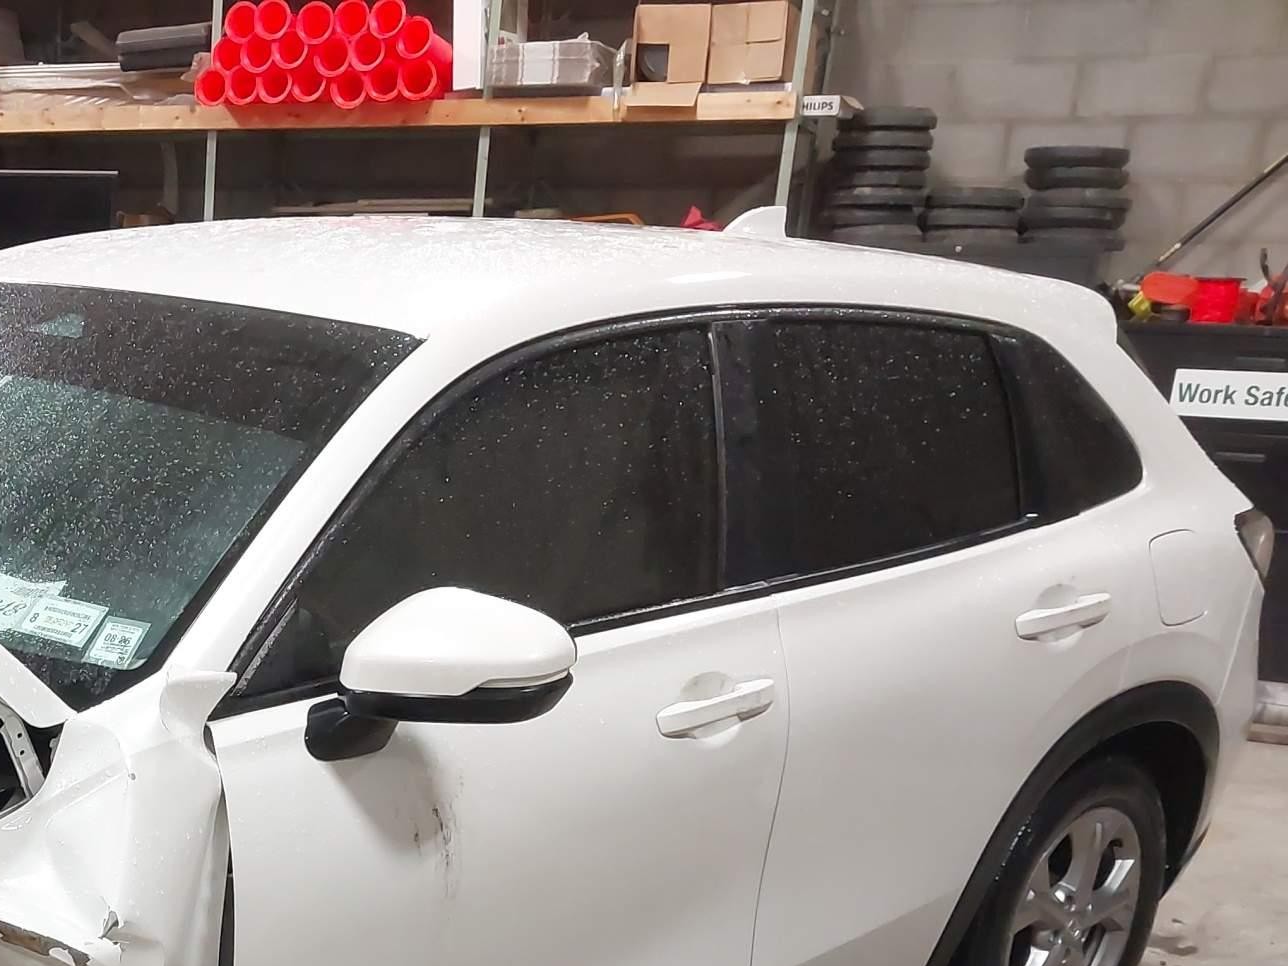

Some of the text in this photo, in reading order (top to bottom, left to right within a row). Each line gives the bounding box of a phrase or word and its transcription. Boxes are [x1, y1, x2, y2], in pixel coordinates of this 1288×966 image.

[802, 101, 834, 111] HILIPS
[1178, 382, 1237, 405] Work
[71, 622, 89, 634] 27
